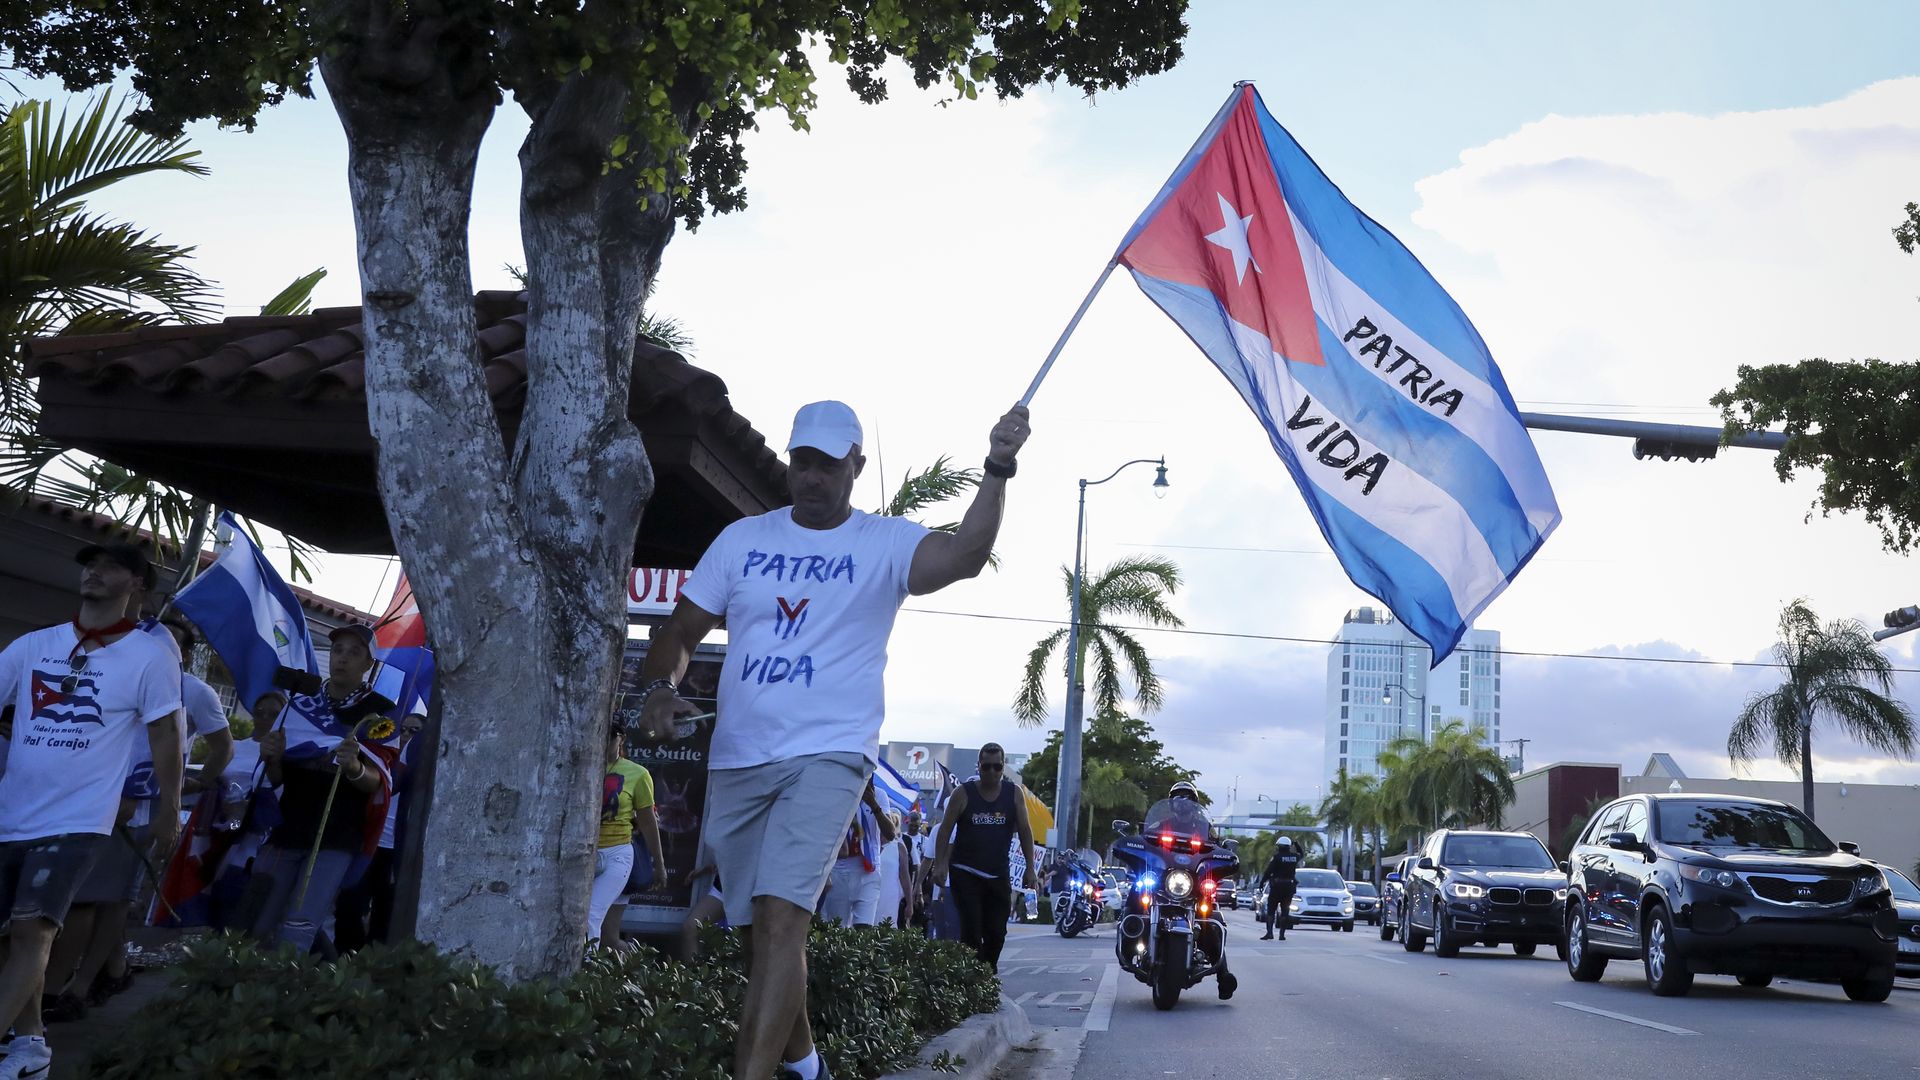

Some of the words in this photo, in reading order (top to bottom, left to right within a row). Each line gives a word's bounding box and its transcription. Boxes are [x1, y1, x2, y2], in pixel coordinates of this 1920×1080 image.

[1344, 315, 1464, 417] PATRIA
[1286, 395, 1390, 496] VIDA
[743, 549, 856, 584] PATRIA
[53, 658, 72, 666] arrib
[741, 653, 816, 688] VIDA
[47, 737, 90, 751] Carajo!
[627, 743, 652, 758] ire
[655, 745, 702, 761] Suite
[898, 769, 940, 780] RKHAUS
[1126, 842, 1145, 850] MIAMI
[1797, 888, 1812, 896] KIA
